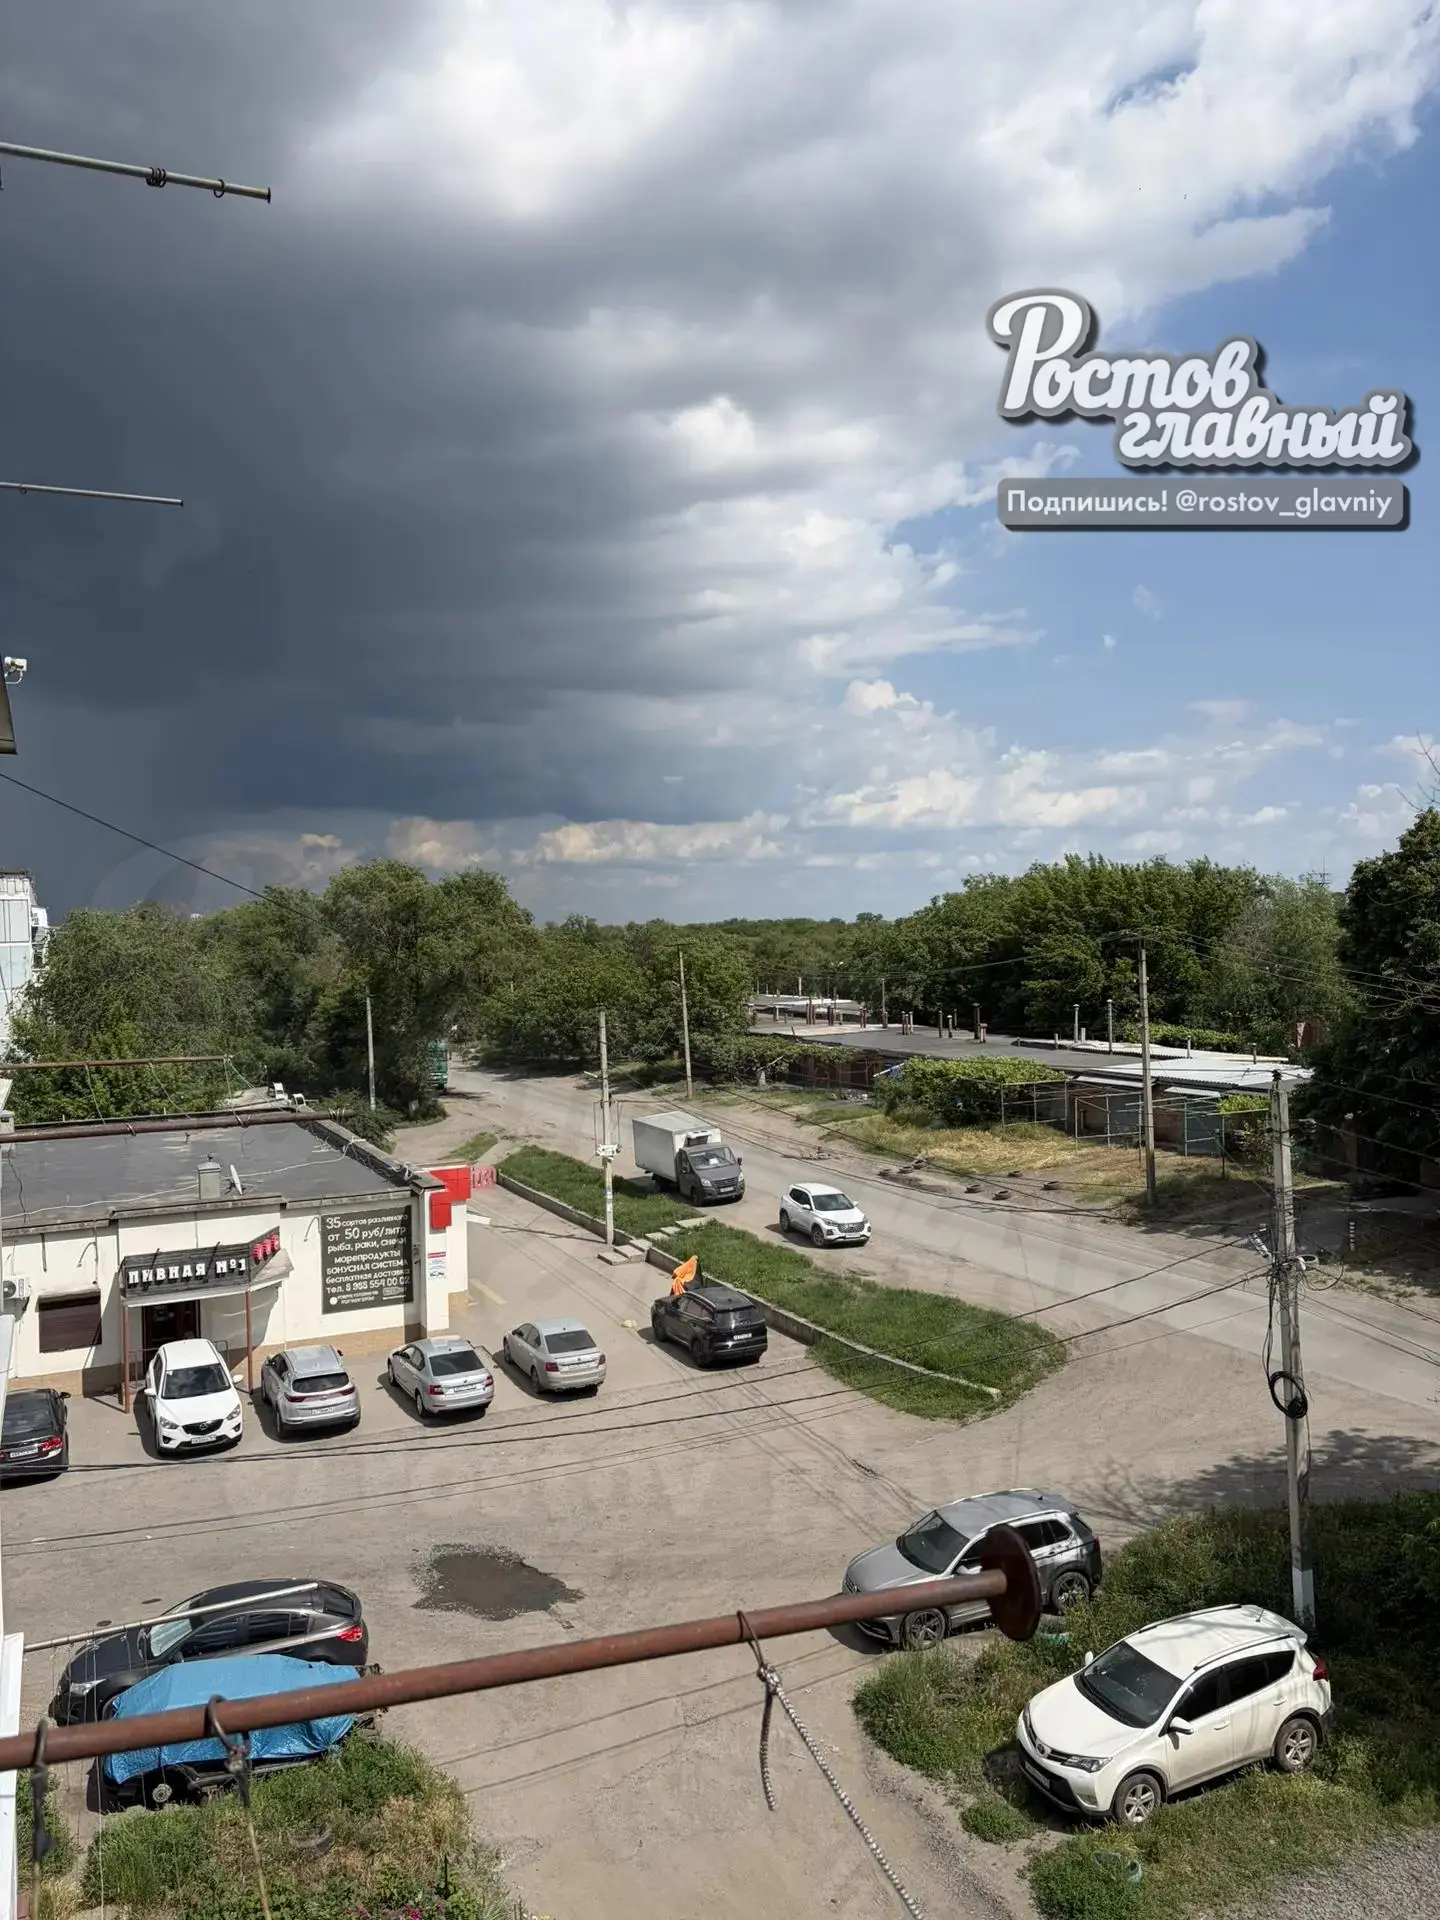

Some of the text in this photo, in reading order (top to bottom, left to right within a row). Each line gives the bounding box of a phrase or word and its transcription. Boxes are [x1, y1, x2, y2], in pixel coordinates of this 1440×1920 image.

[326, 1216, 341, 1229] 35
[341, 1218, 367, 1227] сортов
[328, 1233, 340, 1242] от
[344, 1227, 360, 1240] 50
[355, 1241, 379, 1251] раки,
[371, 1259, 408, 1270] СИСТЕМА
[128, 1263, 206, 1284] ПИВНАЯ
[326, 1286, 344, 1294] тел.
